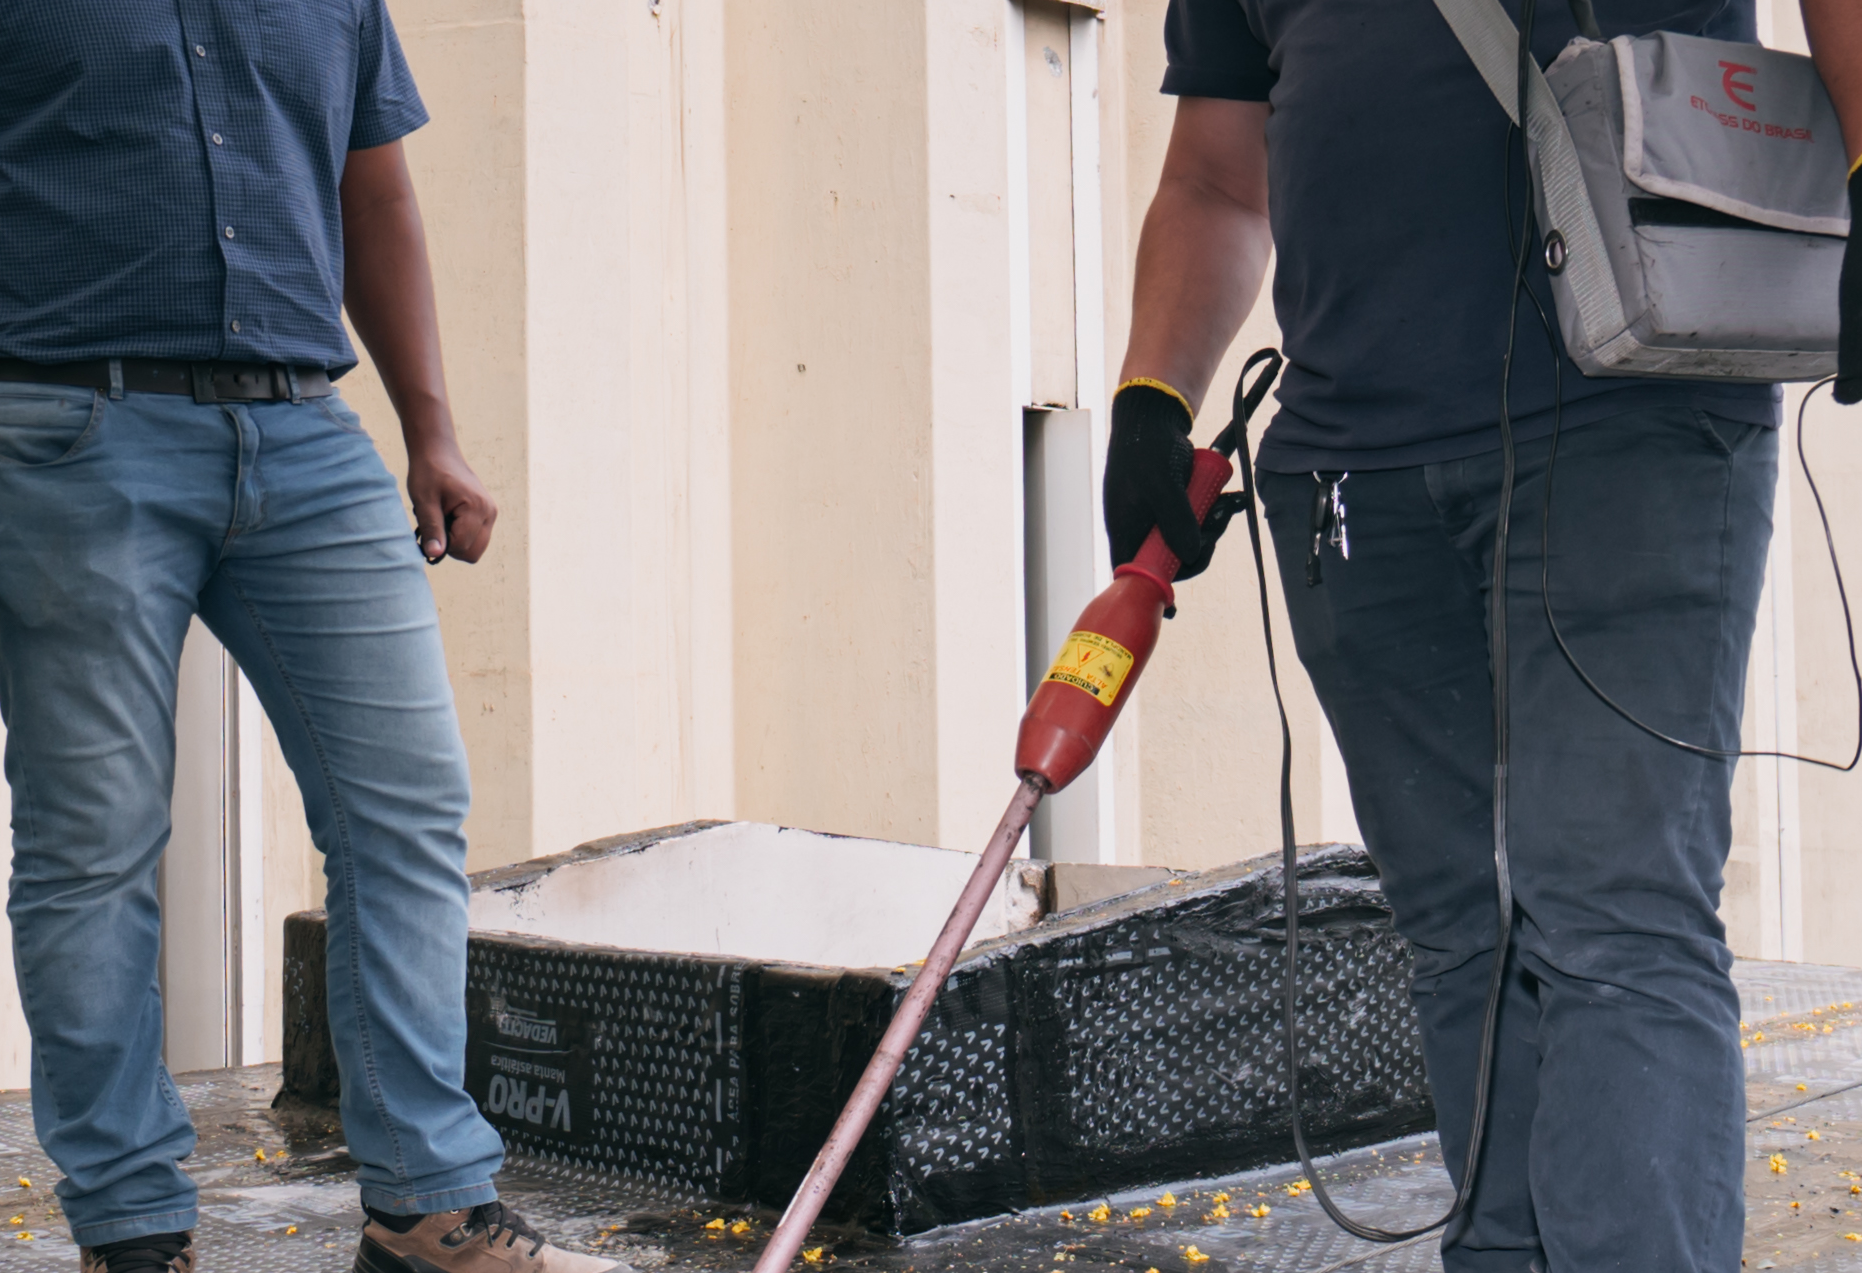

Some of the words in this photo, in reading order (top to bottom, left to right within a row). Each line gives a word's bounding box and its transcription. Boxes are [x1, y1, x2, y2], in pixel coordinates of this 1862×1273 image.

[1742, 118, 1761, 134] DO
[1765, 124, 1815, 144] BRASIL
[1054, 672, 1094, 691] CUIDADO
[1086, 673, 1108, 690] ALTA
[491, 1054, 532, 1073] asfáltica
[534, 1067, 566, 1084] Manta
[487, 1073, 572, 1132] V-PRO
